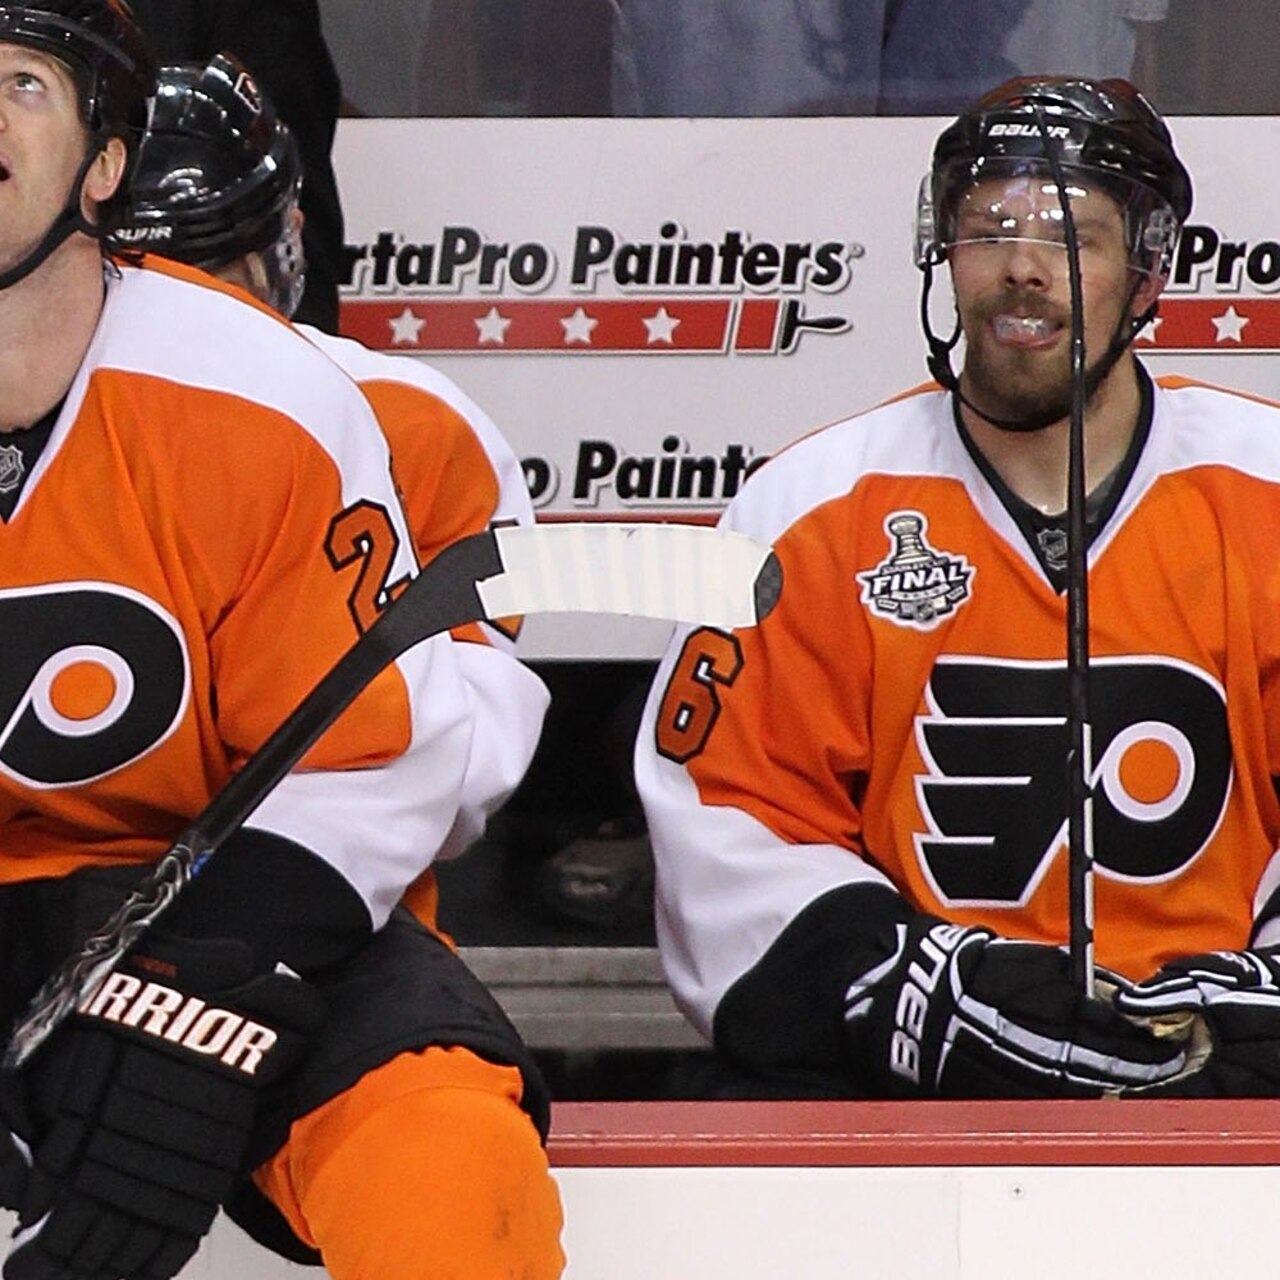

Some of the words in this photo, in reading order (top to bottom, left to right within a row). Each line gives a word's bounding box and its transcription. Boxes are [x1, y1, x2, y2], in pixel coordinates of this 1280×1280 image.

[570, 222, 847, 286] Painters
[872, 565, 965, 595] FINAL
[654, 625, 745, 766] 6
[79, 972, 278, 1075] RRIOR
